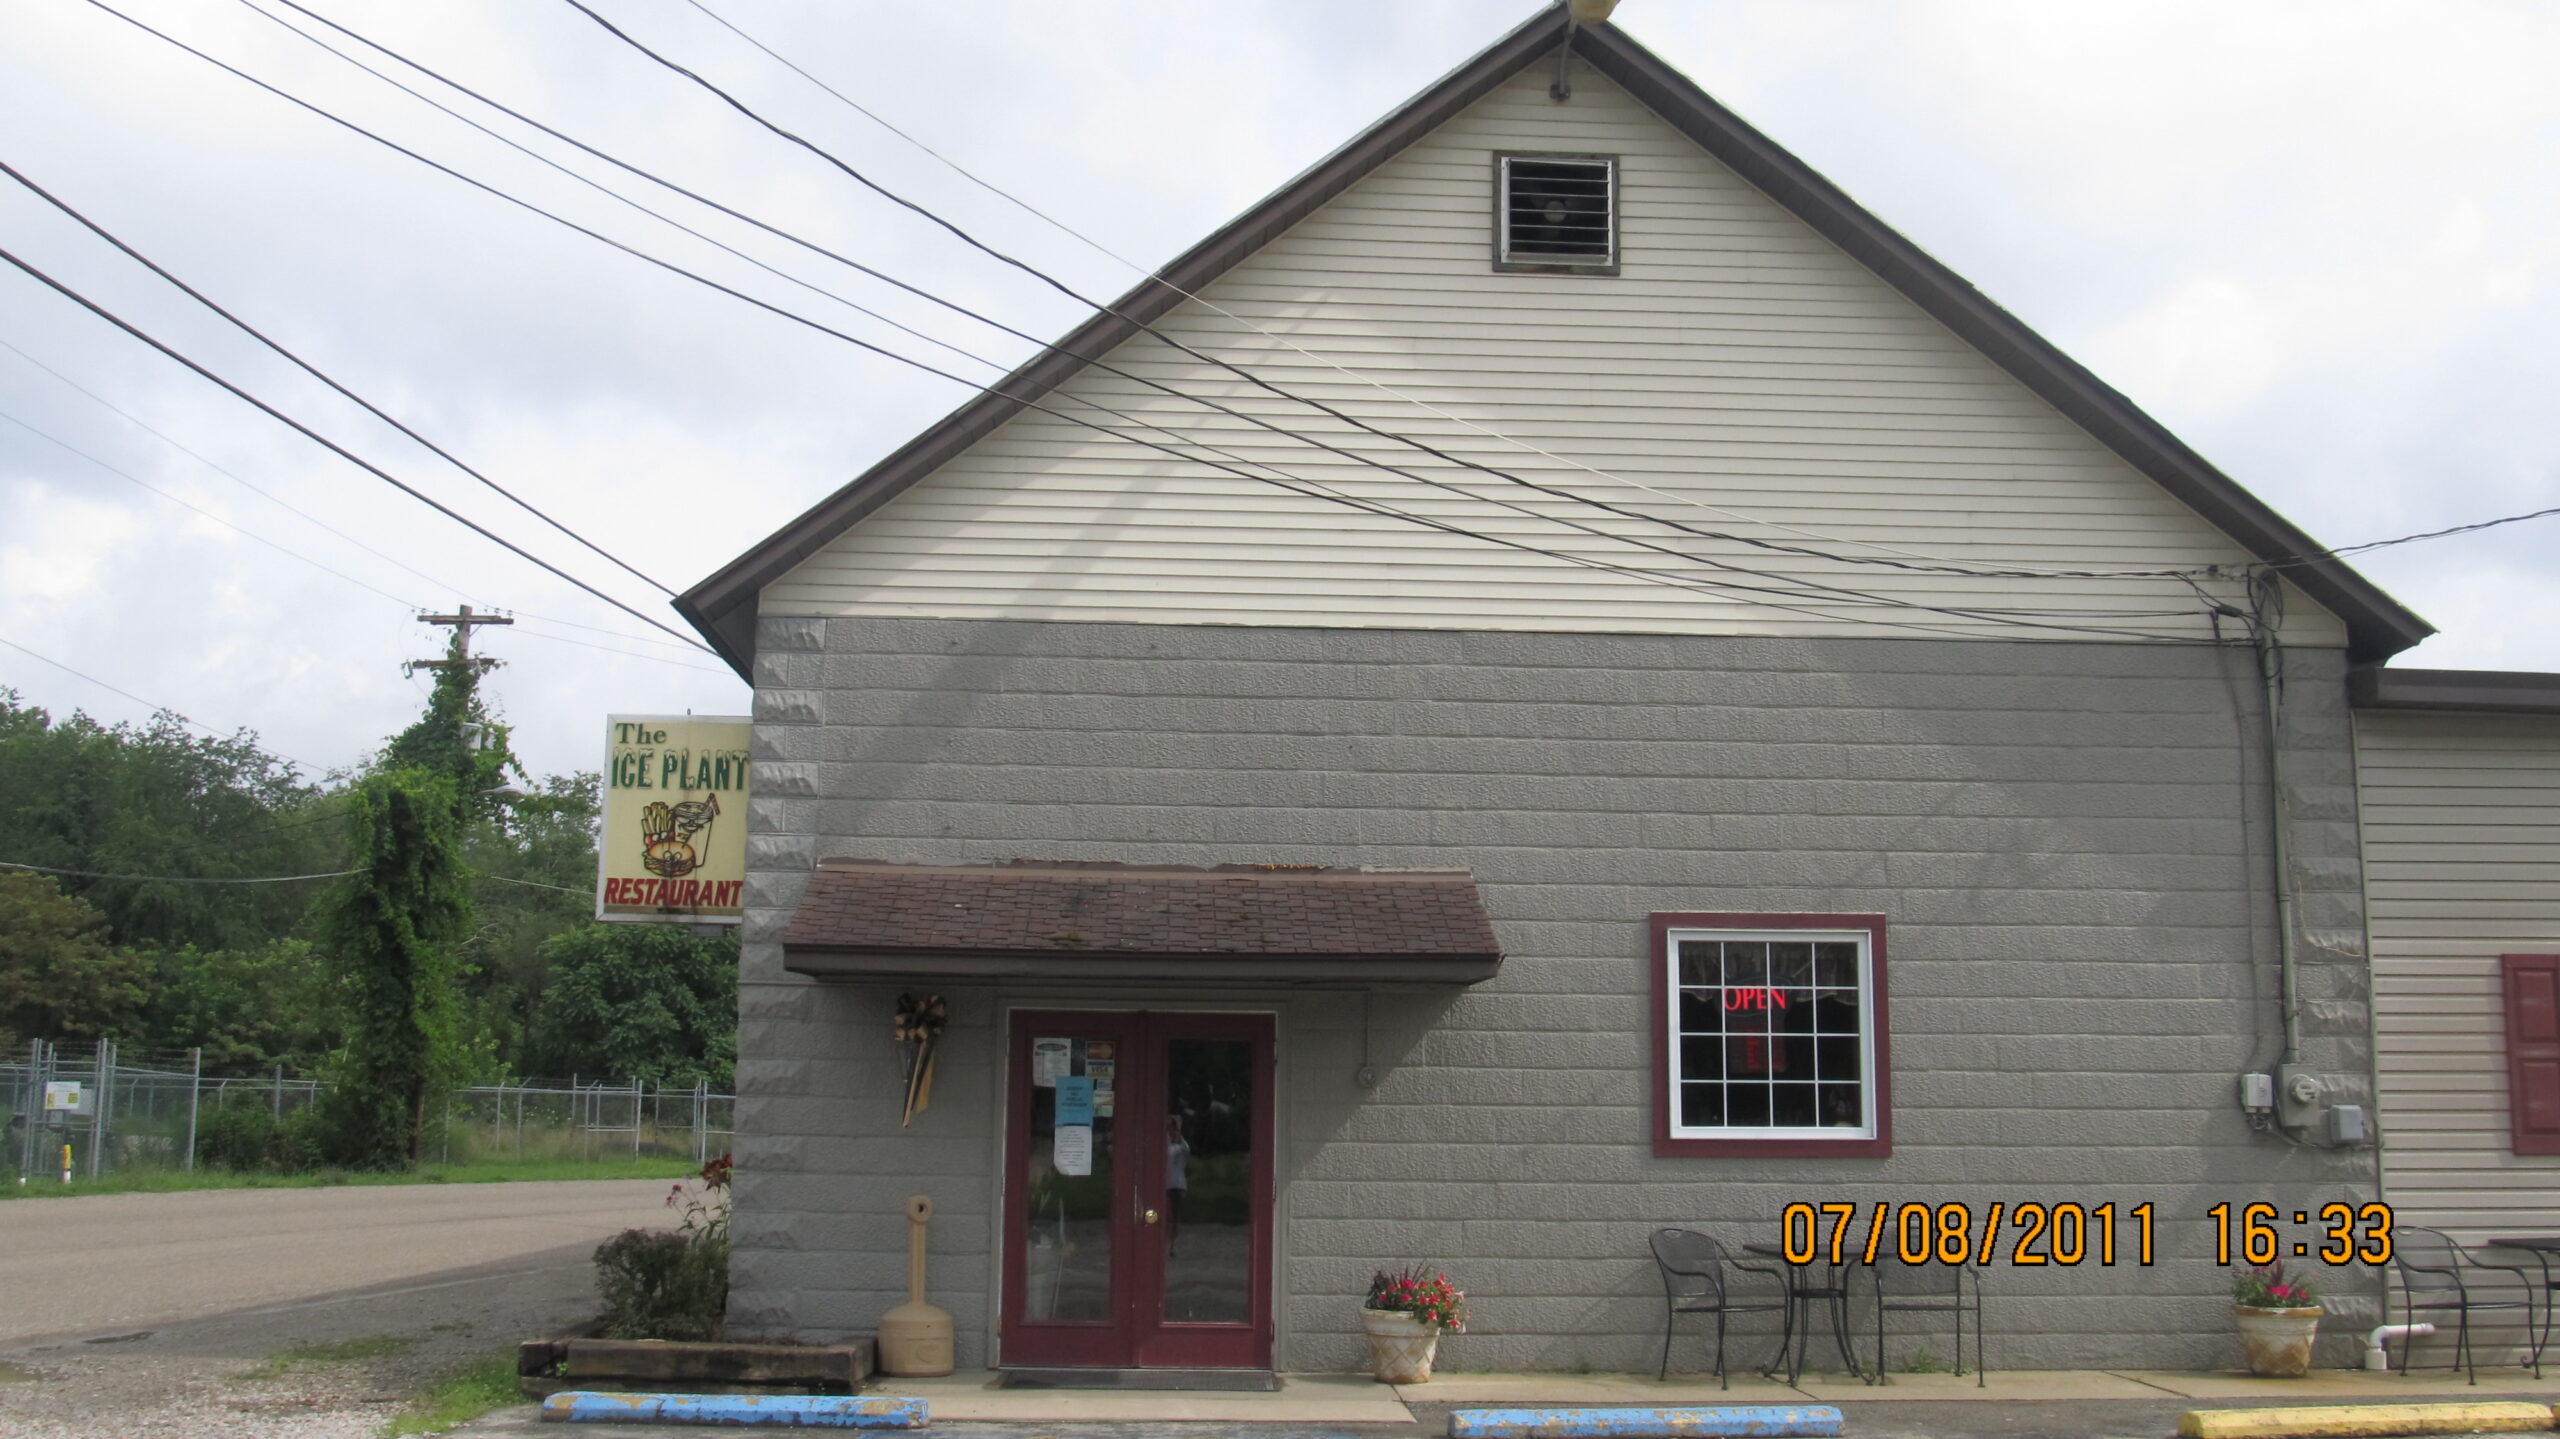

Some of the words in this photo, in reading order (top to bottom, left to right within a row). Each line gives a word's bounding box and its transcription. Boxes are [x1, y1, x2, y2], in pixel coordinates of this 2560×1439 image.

[615, 722, 667, 744] The
[611, 747, 654, 788] ICE
[661, 748, 750, 791] PLANT
[603, 877, 743, 907] RESTAURANT
[1724, 985, 1787, 1010] OPEN
